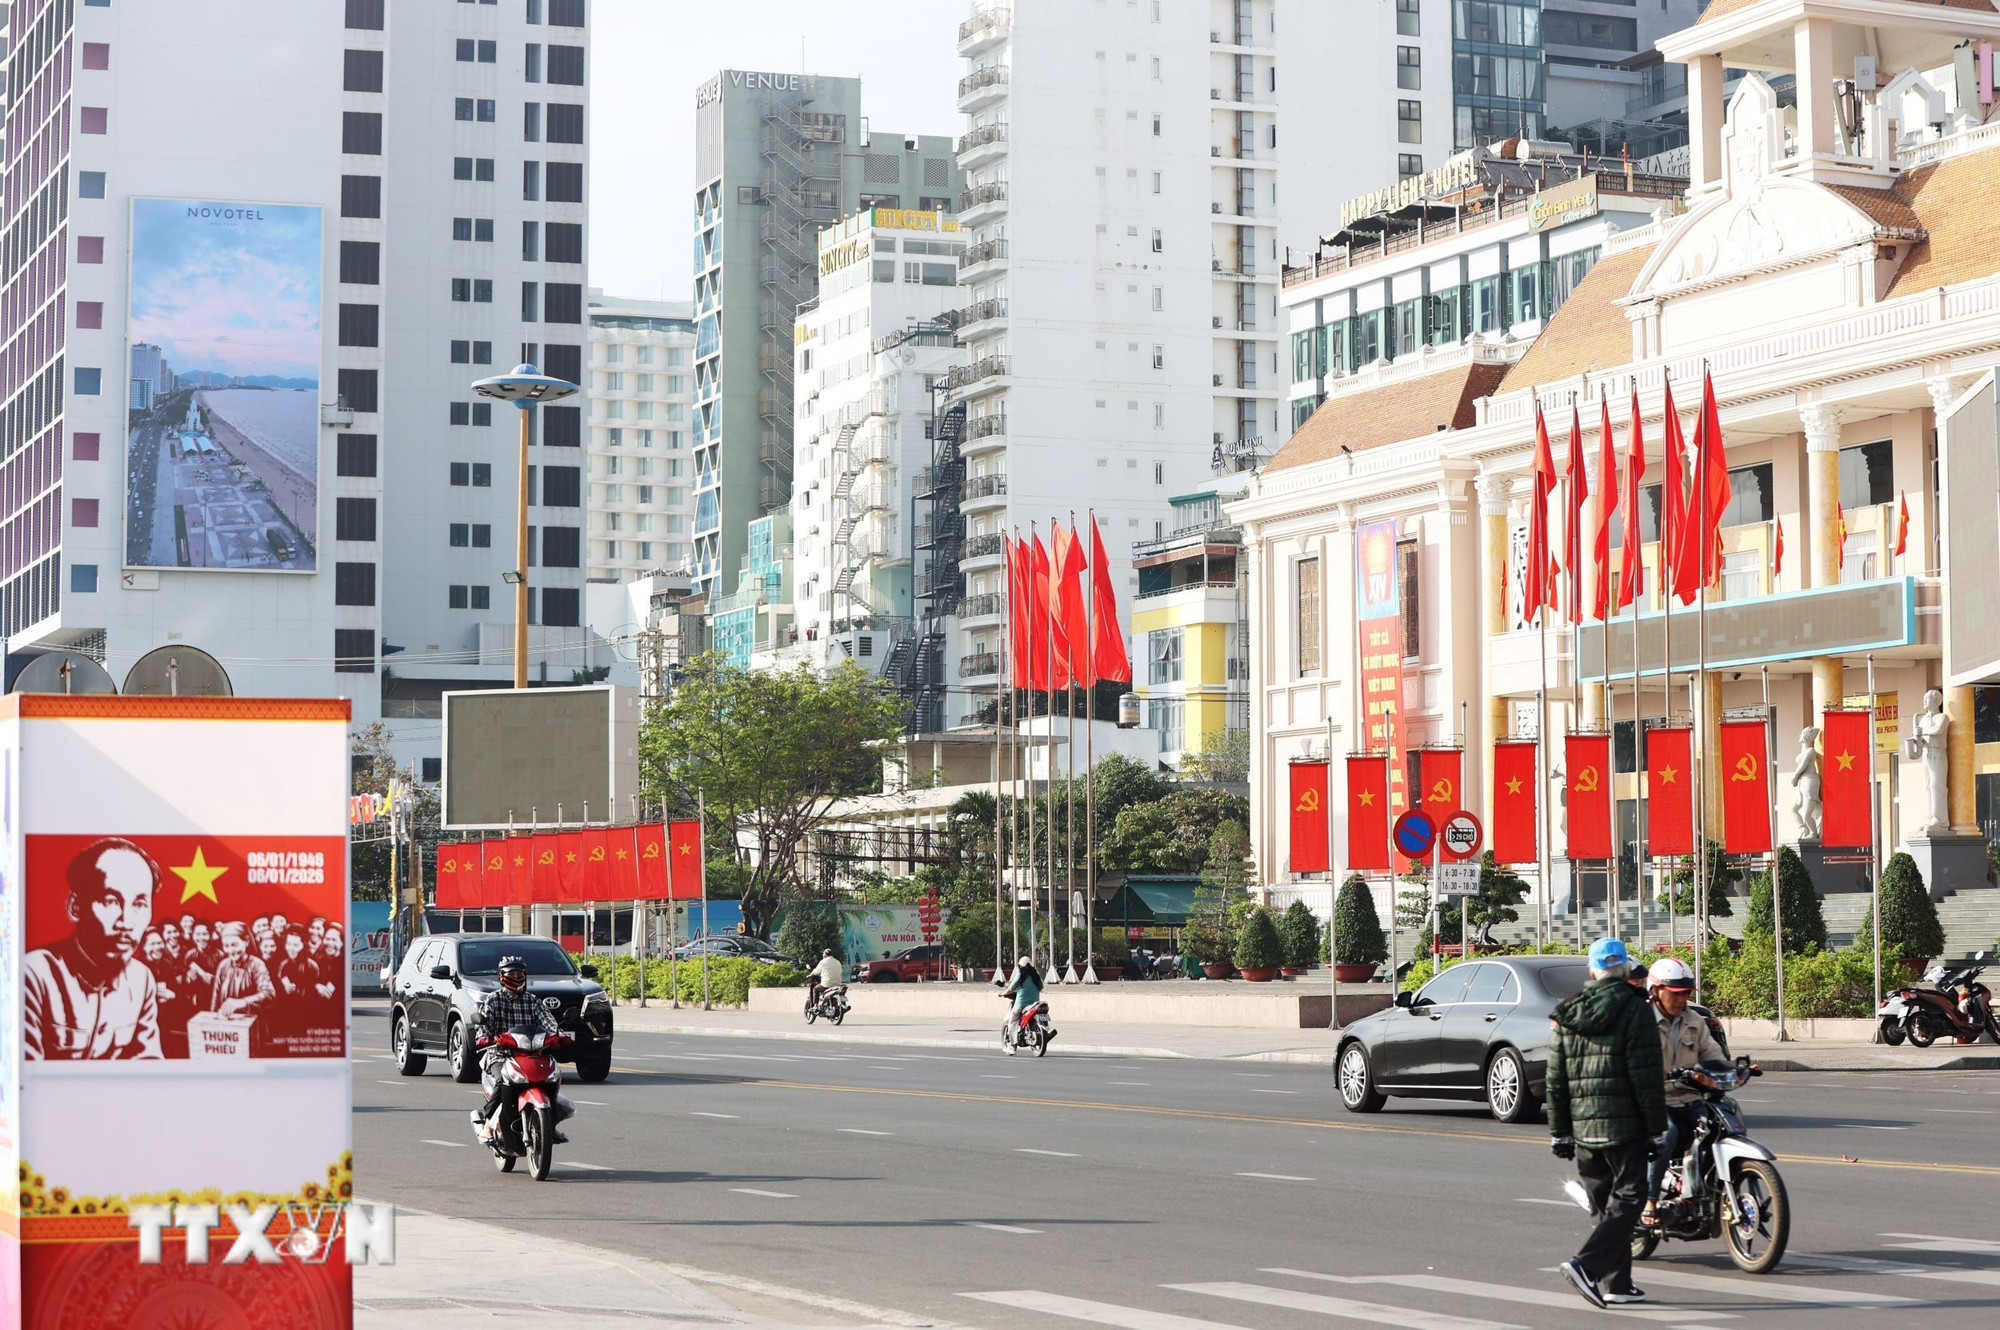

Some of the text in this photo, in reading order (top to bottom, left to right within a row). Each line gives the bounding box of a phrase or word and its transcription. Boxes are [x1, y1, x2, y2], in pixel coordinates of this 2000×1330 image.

[729, 71, 799, 91] VENUE
[1340, 155, 1478, 229] HAPPY LIGHT HOTEL
[187, 207, 264, 221] NOVOTEL
[875, 207, 902, 229] SUN
[903, 209, 938, 231] CITY
[820, 248, 838, 277] SUN
[837, 239, 858, 270] CITY
[1368, 573, 1387, 601] XIV
[247, 851, 324, 868] 06/01/1946
[247, 867, 324, 884] 06/01/2026
[1445, 868, 1458, 878] 6:30
[1463, 868, 1476, 878] 7:30
[1442, 881, 1458, 891] 16:30
[1463, 881, 1478, 891] 18:30
